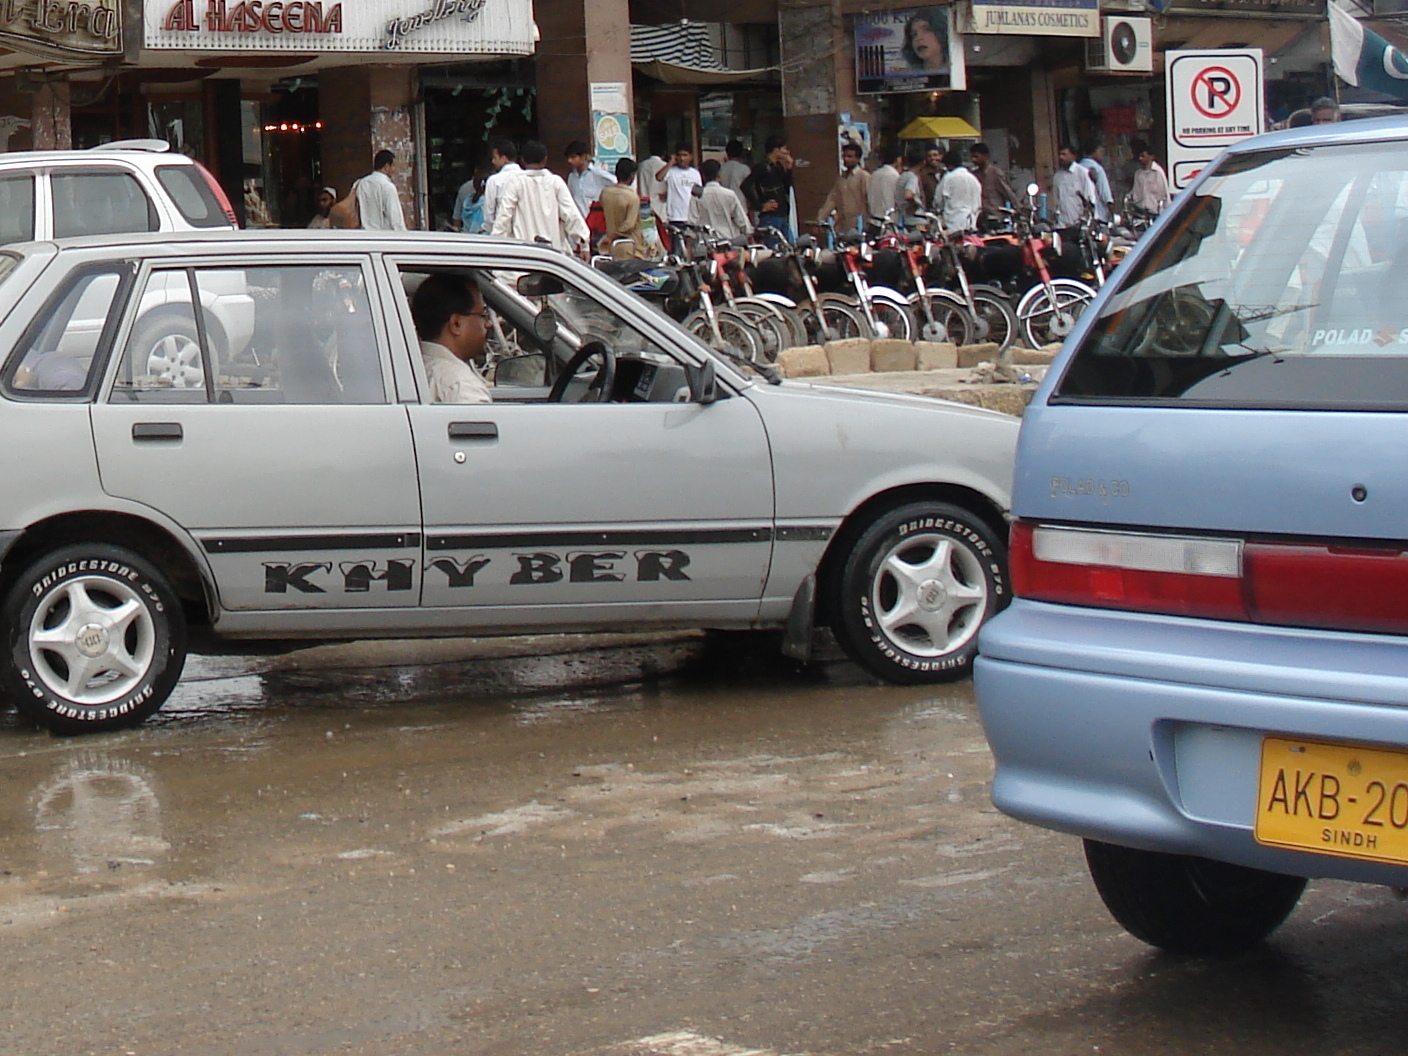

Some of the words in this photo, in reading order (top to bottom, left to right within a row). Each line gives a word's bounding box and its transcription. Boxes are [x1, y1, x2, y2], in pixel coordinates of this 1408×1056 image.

[1038, 12, 1089, 28] COSMETICS
[1207, 77, 1231, 109] P
[1191, 126, 1216, 134] PARKING
[1217, 126, 1224, 134] AT
[1312, 328, 1373, 346] POLAD
[898, 518, 992, 557] BRIDGESTONE
[32, 560, 139, 597] BRIDGESTONE
[261, 549, 691, 594] KHYBER
[871, 634, 966, 671] BRIDGESTONE
[46, 683, 155, 720] BRIDGESTONE
[1267, 768, 1408, 829] AKB-20
[1321, 828, 1377, 849] SINDH
